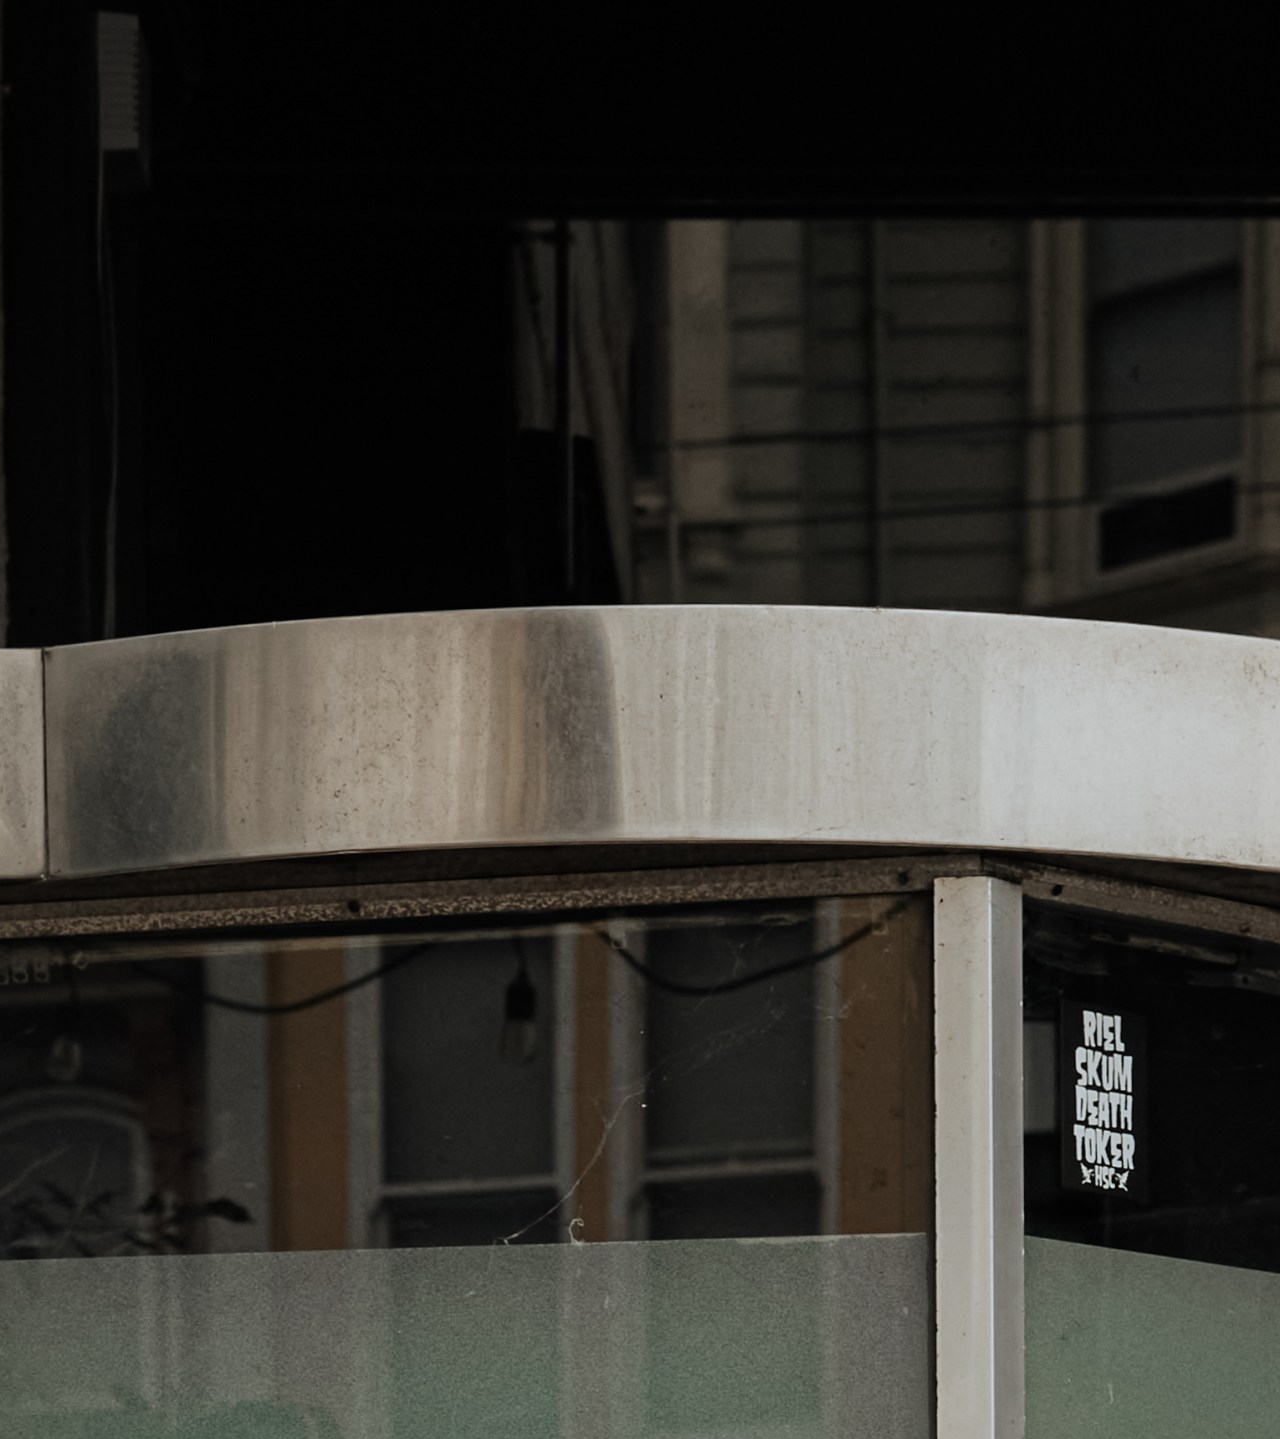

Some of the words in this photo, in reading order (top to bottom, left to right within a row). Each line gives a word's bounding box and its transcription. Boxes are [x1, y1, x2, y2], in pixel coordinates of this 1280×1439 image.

[1083, 1010, 1125, 1051] RIEL
[1074, 1046, 1133, 1093] SKUM
[1074, 1084, 1133, 1131] DEATH
[1073, 1123, 1135, 1170] TOKER
[1094, 1164, 1116, 1190] HSC
